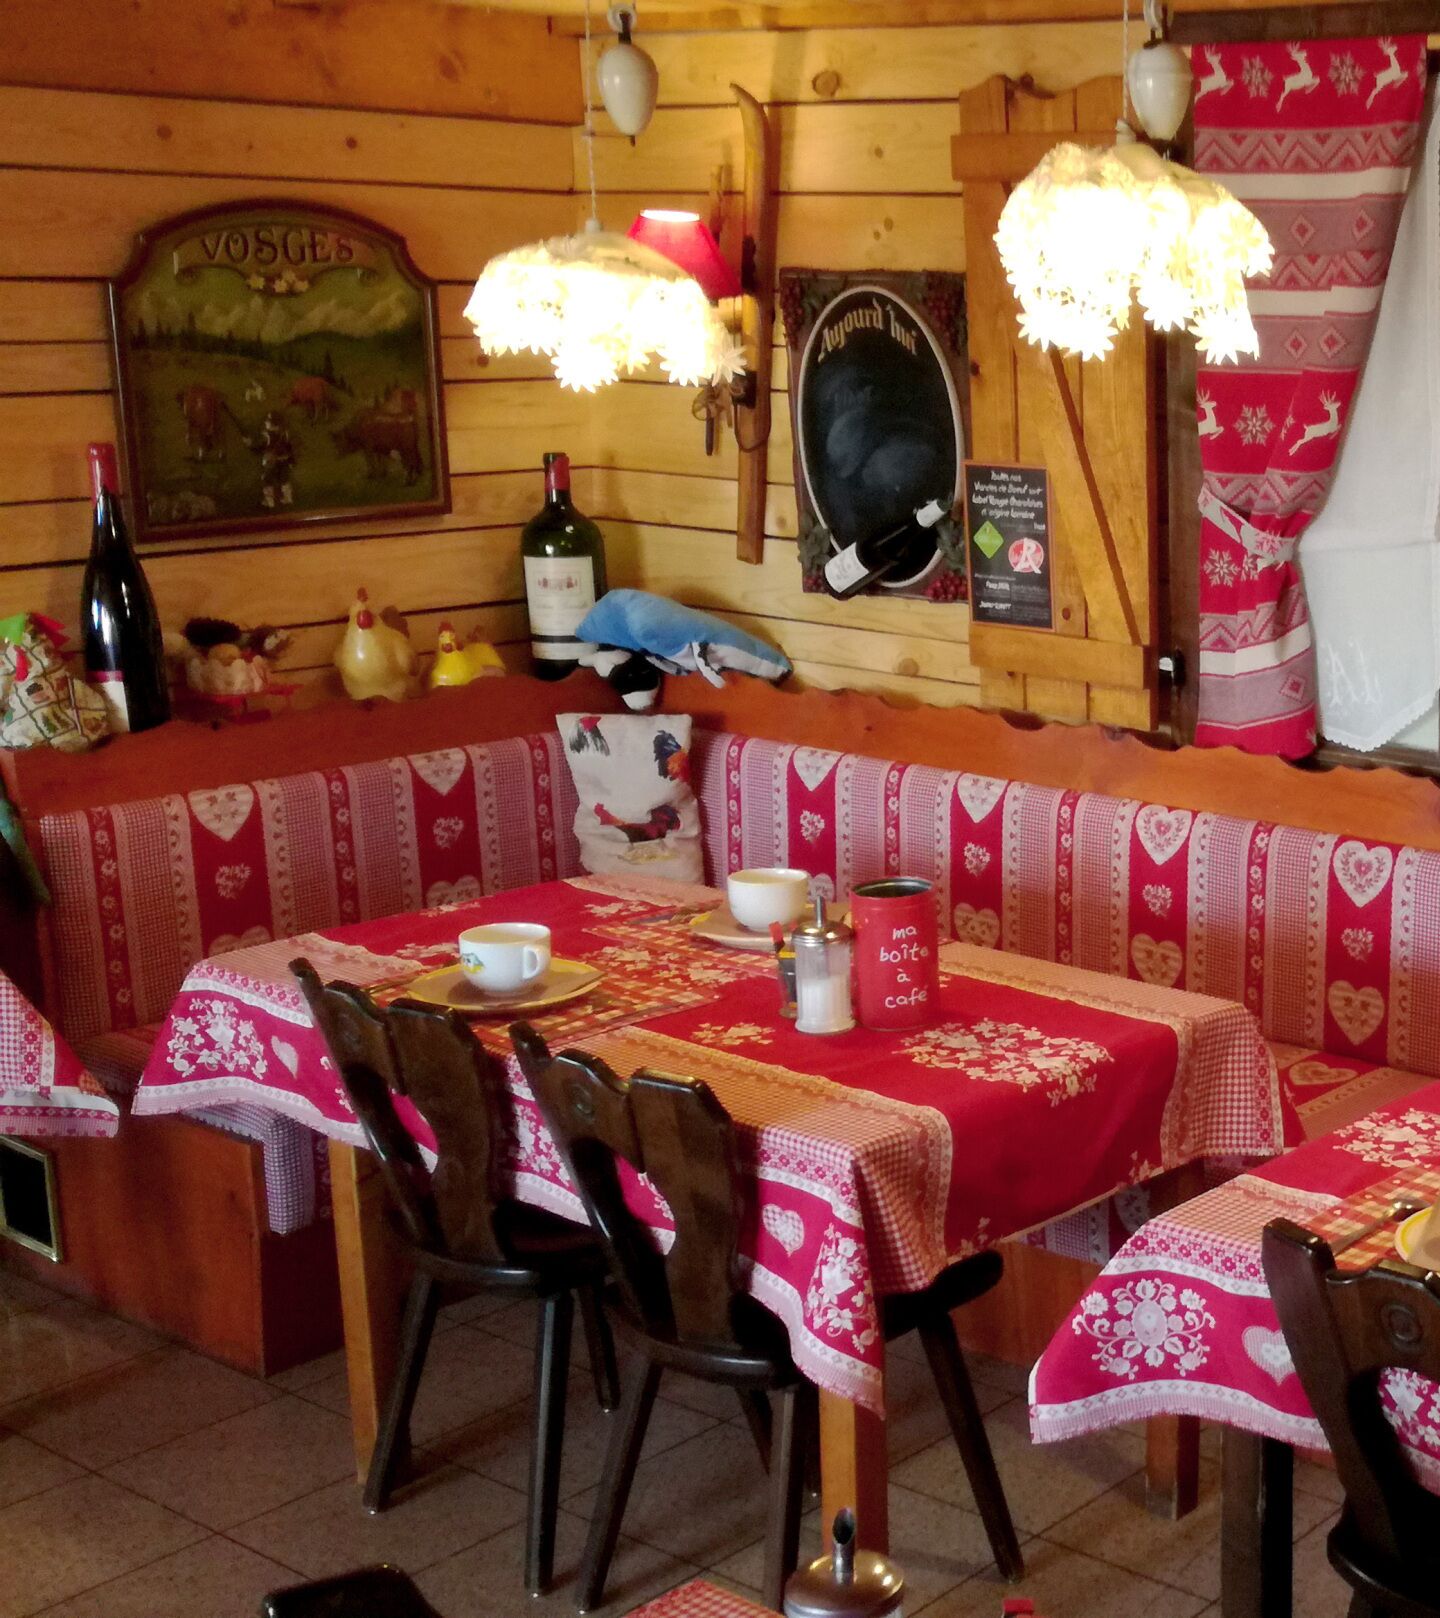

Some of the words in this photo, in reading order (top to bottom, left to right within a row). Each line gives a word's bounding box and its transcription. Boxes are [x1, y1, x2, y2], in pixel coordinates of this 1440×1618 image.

[202, 229, 354, 265] VOSGES
[892, 926, 917, 940] ma
[880, 943, 929, 962] boîte
[896, 968, 911, 983] à
[885, 985, 928, 1008] café
